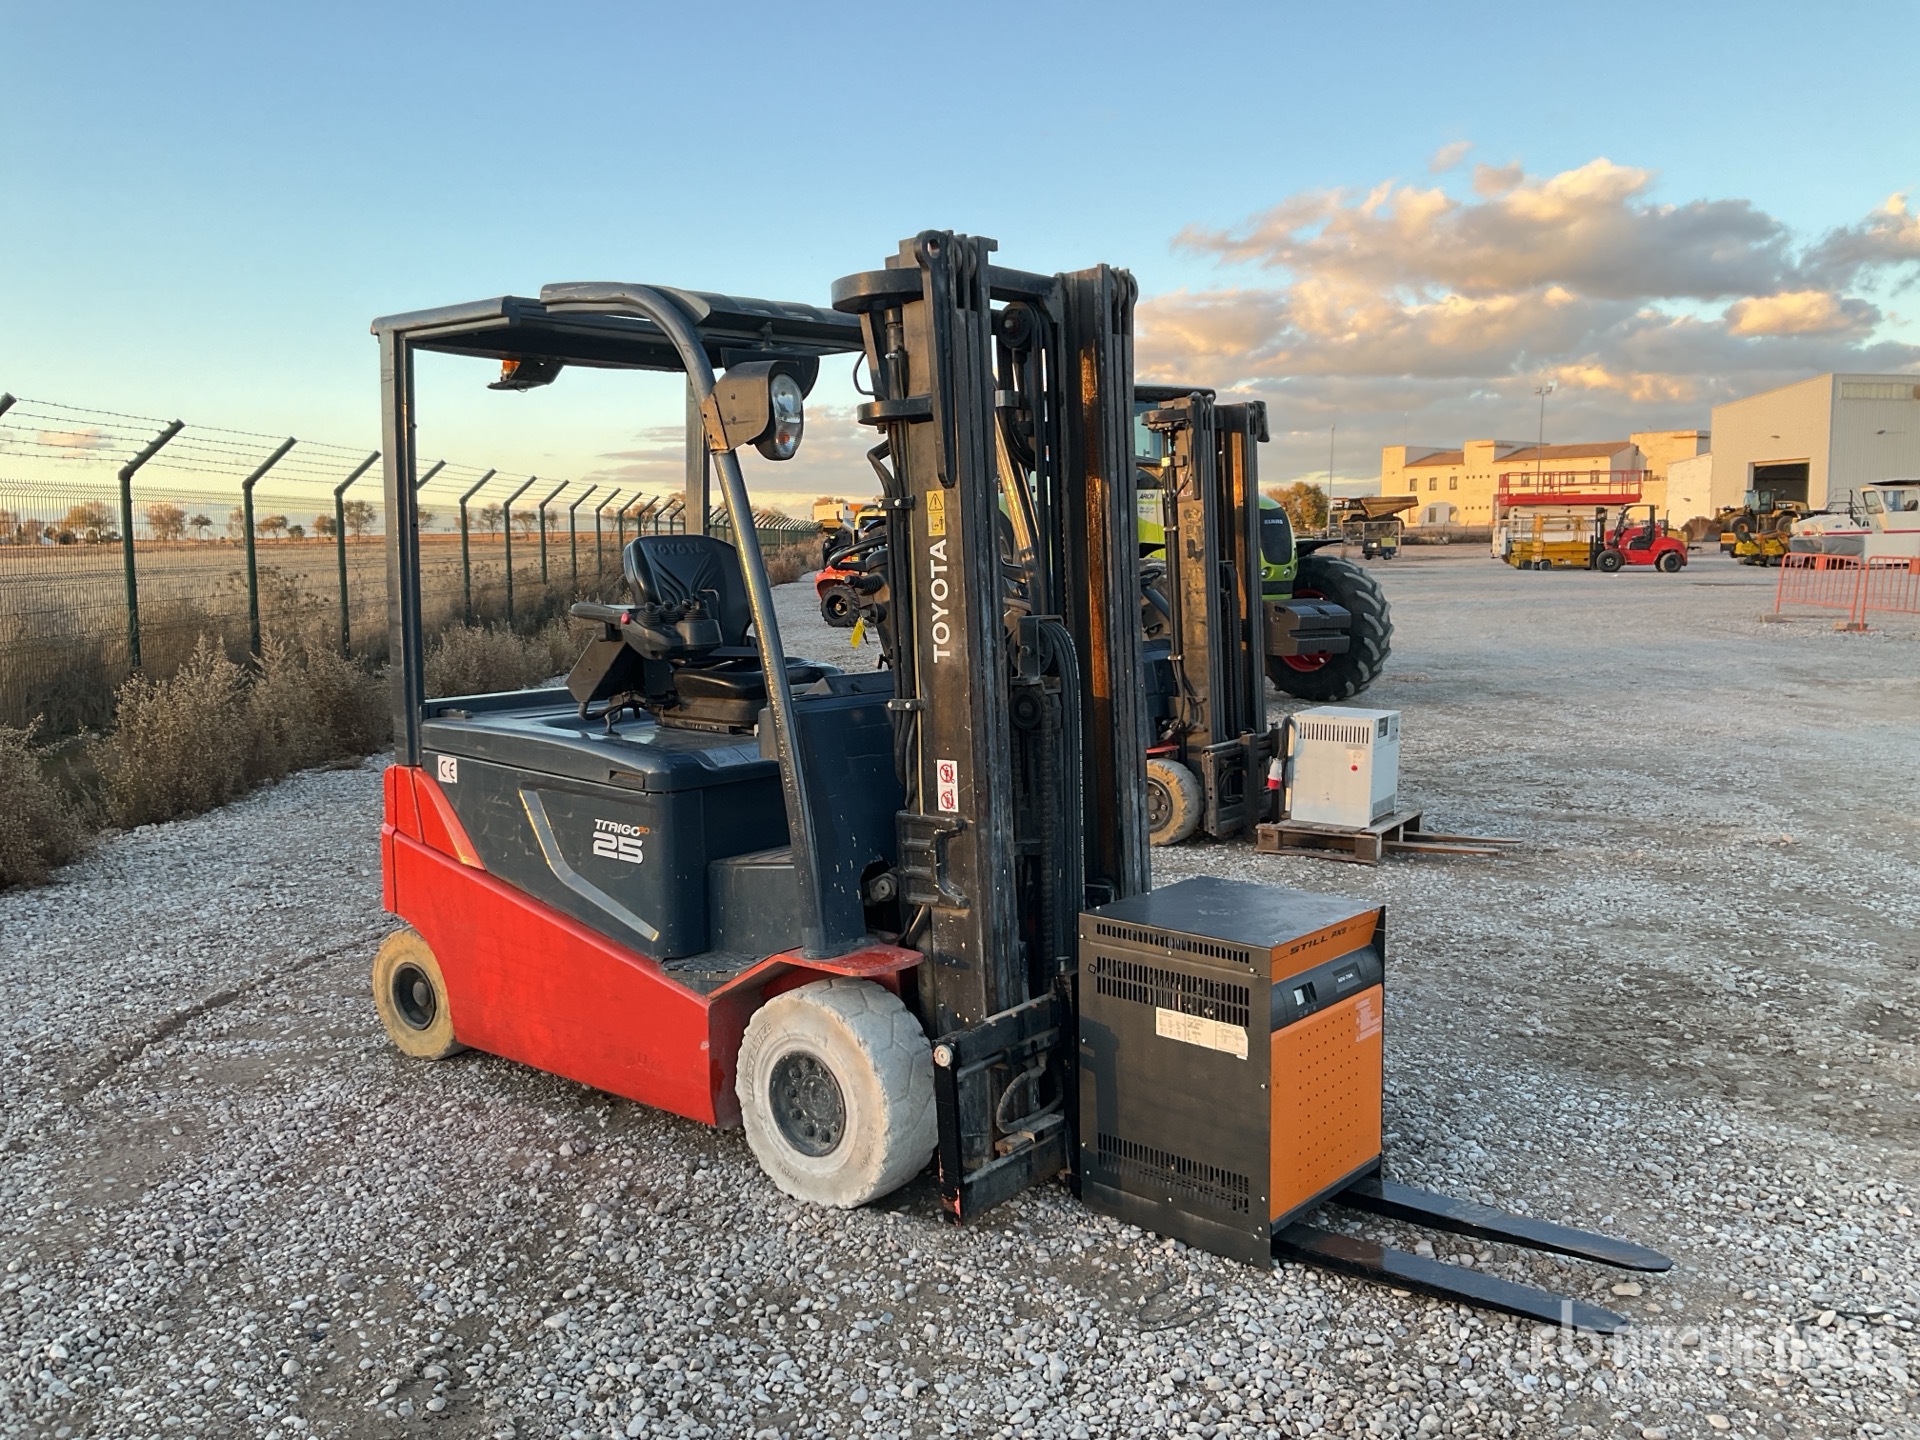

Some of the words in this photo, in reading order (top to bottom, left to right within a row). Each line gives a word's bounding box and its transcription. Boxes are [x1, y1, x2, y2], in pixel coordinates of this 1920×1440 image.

[929, 538, 949, 663] TOYOTA
[592, 831, 644, 864] 25
[1290, 936, 1328, 955] STILL
